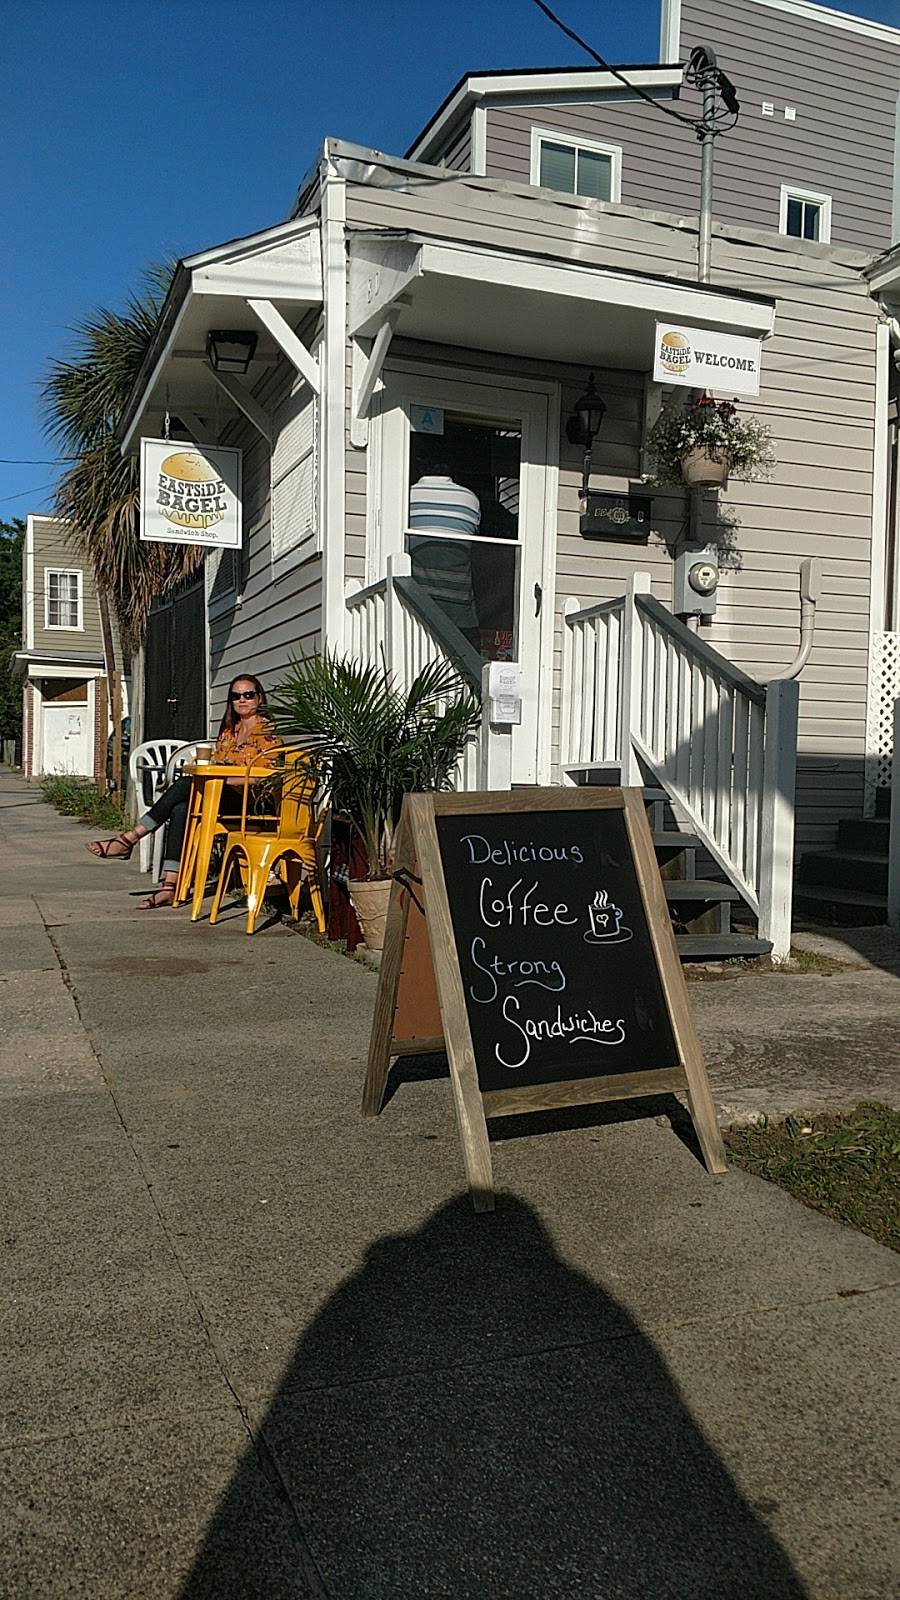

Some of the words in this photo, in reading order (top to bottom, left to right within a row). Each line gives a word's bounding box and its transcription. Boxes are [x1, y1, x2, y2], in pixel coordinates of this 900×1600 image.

[659, 350, 692, 365] BAGEL
[694, 350, 757, 373] WELCOME.
[421, 410, 434, 426] A
[156, 488, 228, 514] BAGEL
[167, 527, 200, 537] Sandwich
[460, 834, 584, 866] Delicious
[479, 877, 579, 928] Coffee
[470, 936, 567, 1004] Strong
[495, 994, 626, 1069] Sandwiches
